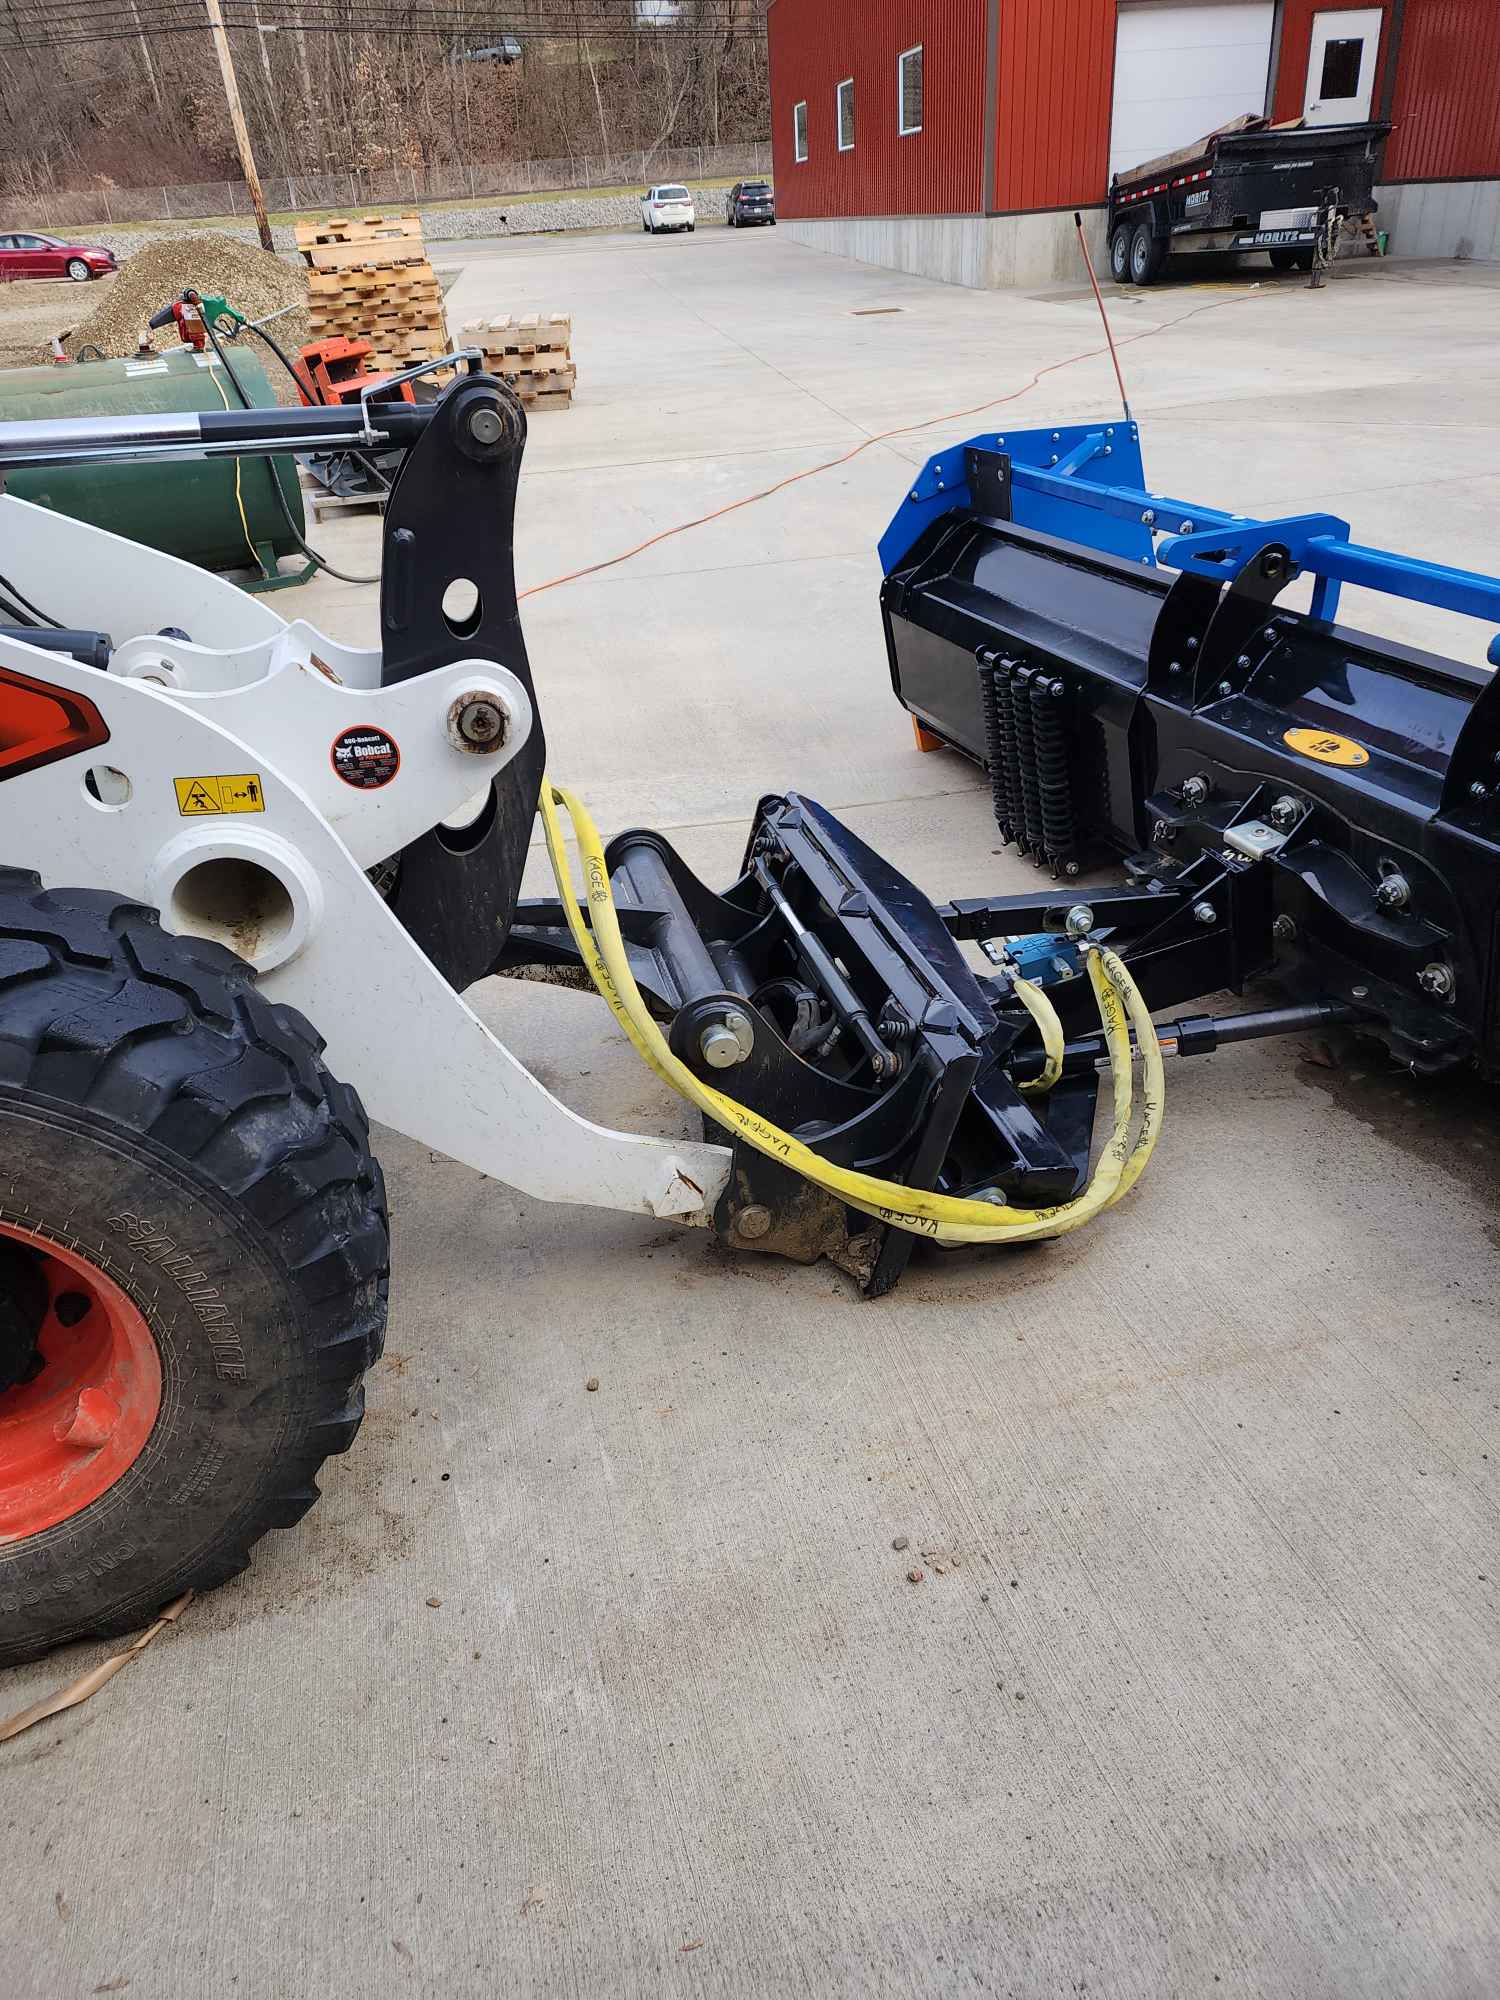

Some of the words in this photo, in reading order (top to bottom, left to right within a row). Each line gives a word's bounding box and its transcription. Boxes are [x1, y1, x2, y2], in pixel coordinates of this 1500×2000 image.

[1186, 190, 1210, 207] MORITZ
[1255, 230, 1299, 243] MORITZ
[354, 743, 391, 757] Bobcat
[585, 855, 605, 889] KAGE
[1104, 1000, 1121, 1037] KAGE
[128, 1236, 247, 1381] ALLIANCE
